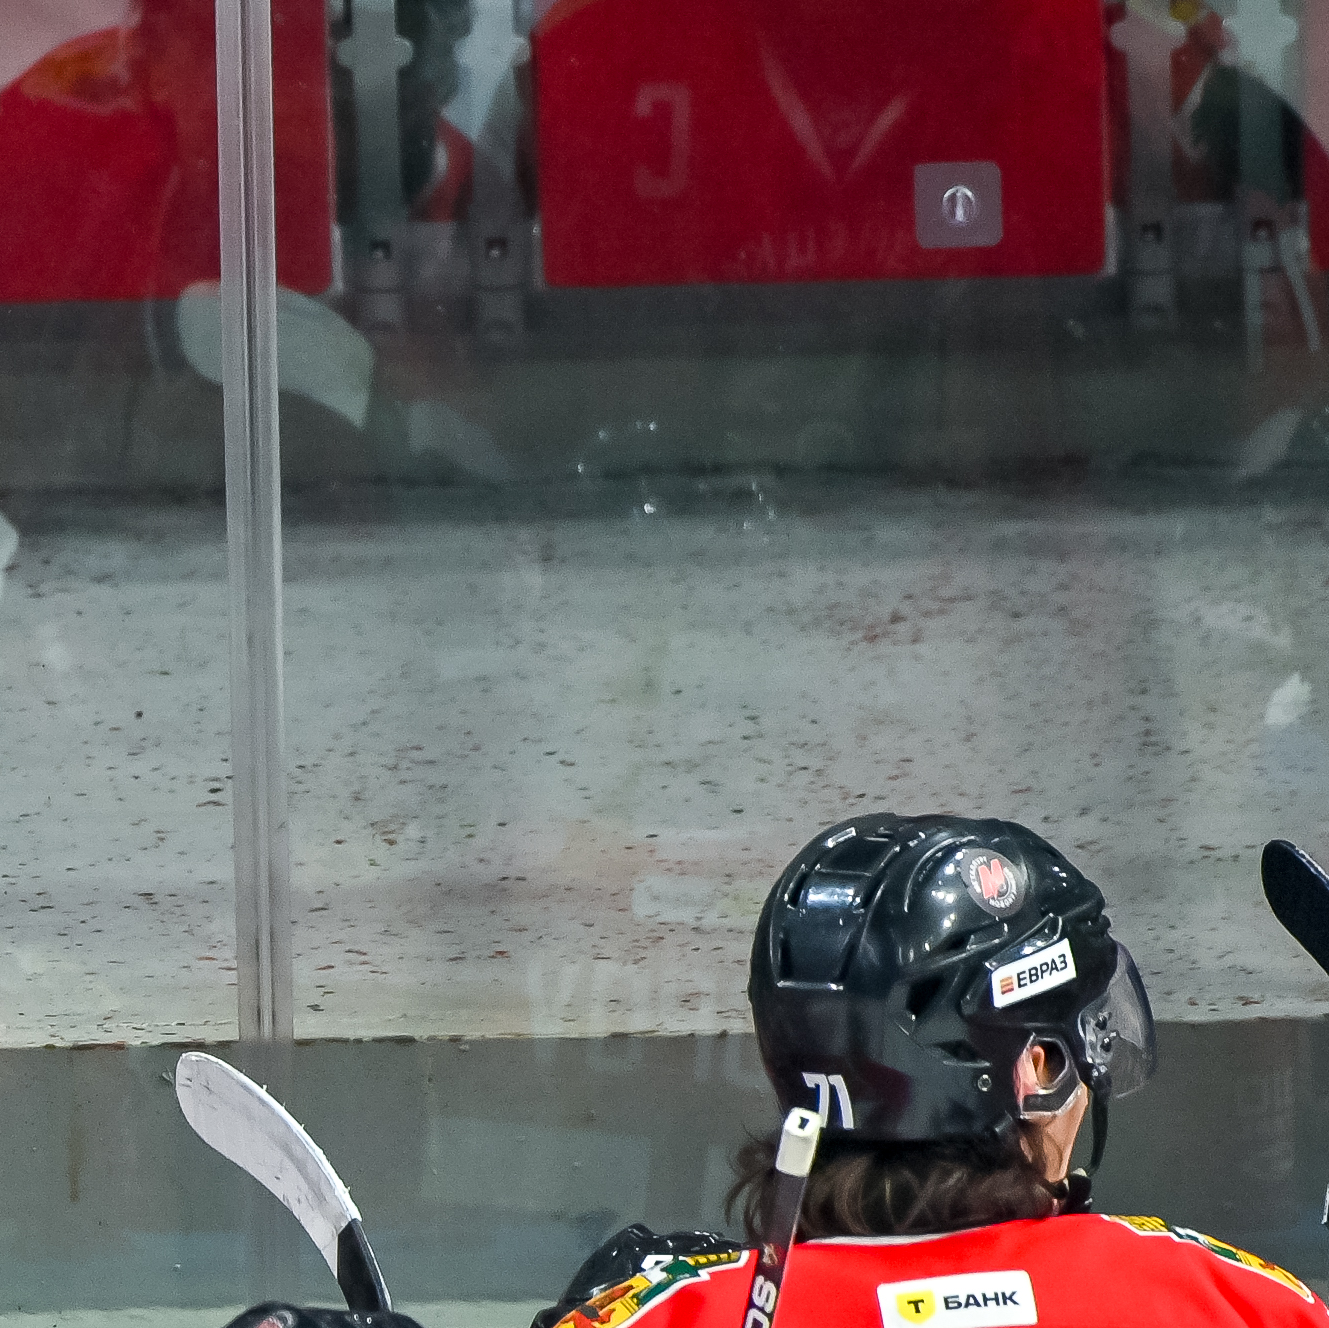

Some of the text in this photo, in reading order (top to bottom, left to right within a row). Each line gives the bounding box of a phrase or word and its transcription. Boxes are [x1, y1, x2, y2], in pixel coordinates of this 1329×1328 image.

[1015, 953, 1070, 990] ЕВРАЗ
[801, 1072, 855, 1130] 71
[943, 1288, 1021, 1311] БАНК
